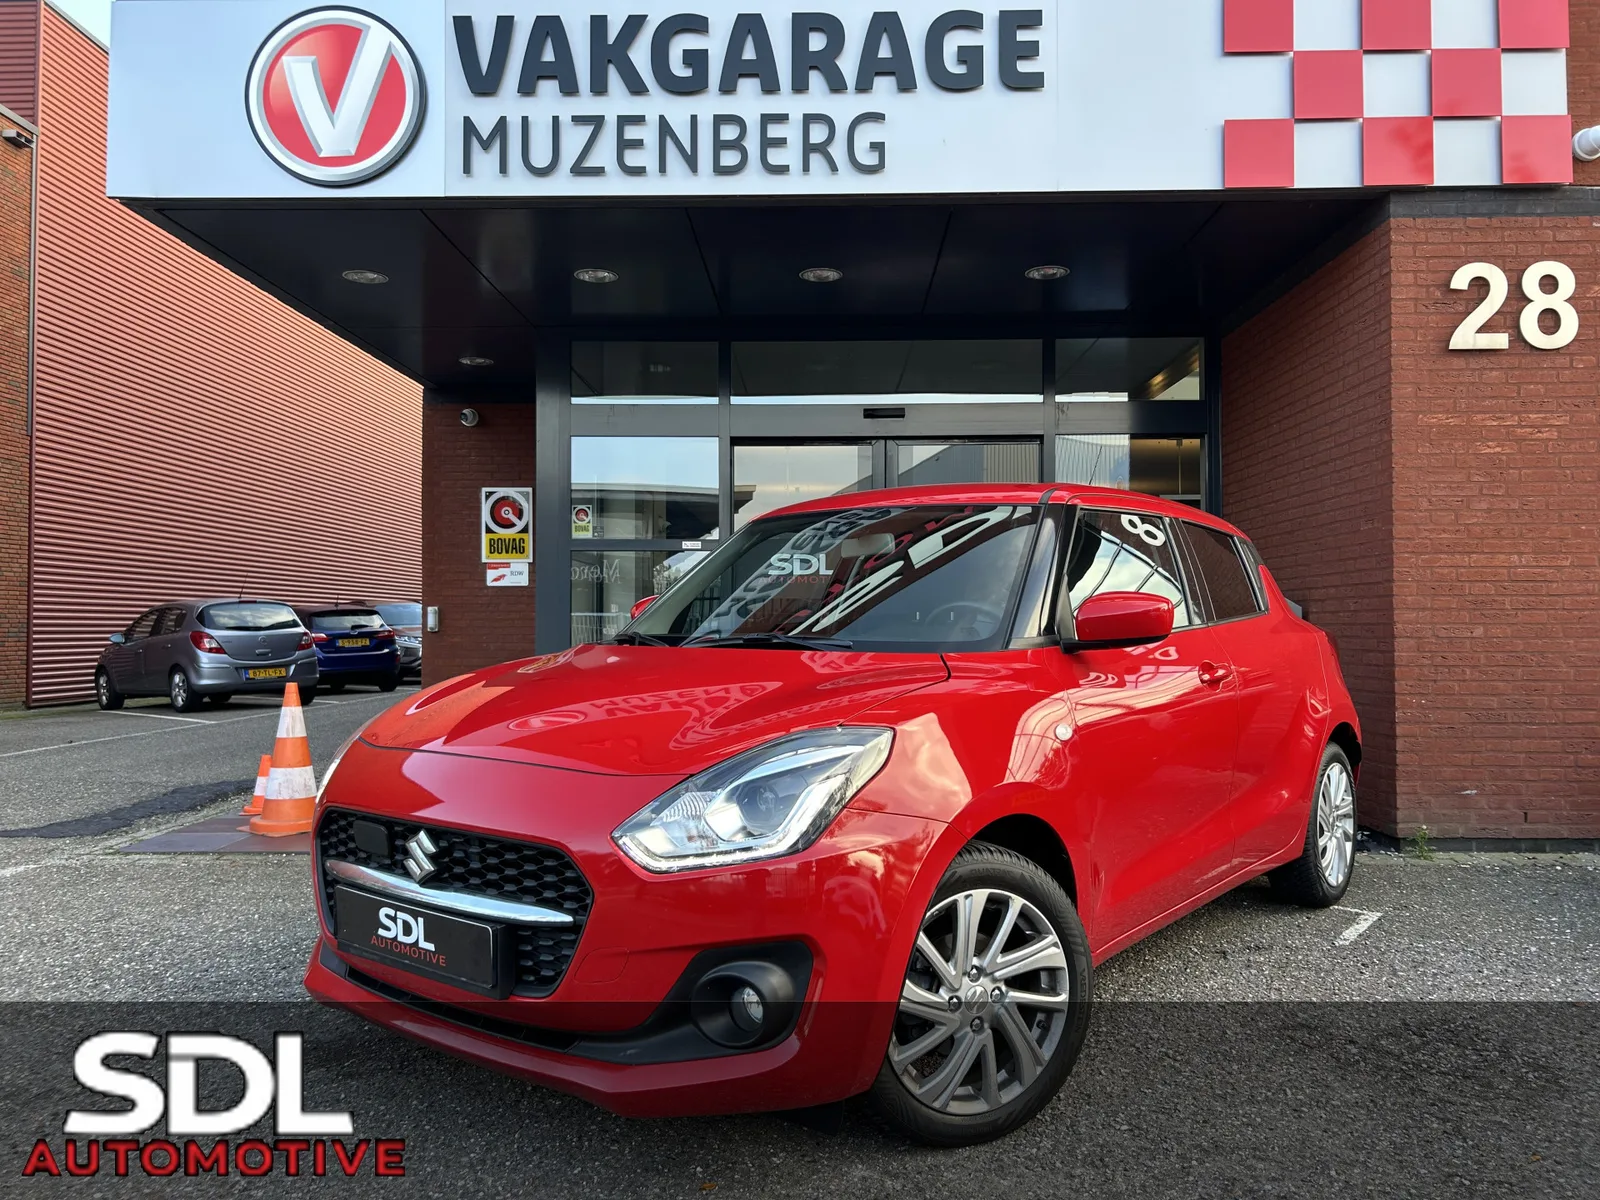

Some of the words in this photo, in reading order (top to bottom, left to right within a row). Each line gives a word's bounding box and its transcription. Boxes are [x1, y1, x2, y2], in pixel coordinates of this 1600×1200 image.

[452, 9, 1046, 95] VAKGARAGE
[462, 111, 887, 176] MUZENBERG
[1448, 260, 1580, 350] 28
[488, 536, 526, 555] BOVAG
[758, 575, 832, 585] AUTOMOT
[767, 553, 834, 576] SDL
[378, 907, 435, 951] SDL
[371, 935, 446, 966] AUTOMOTIVE
